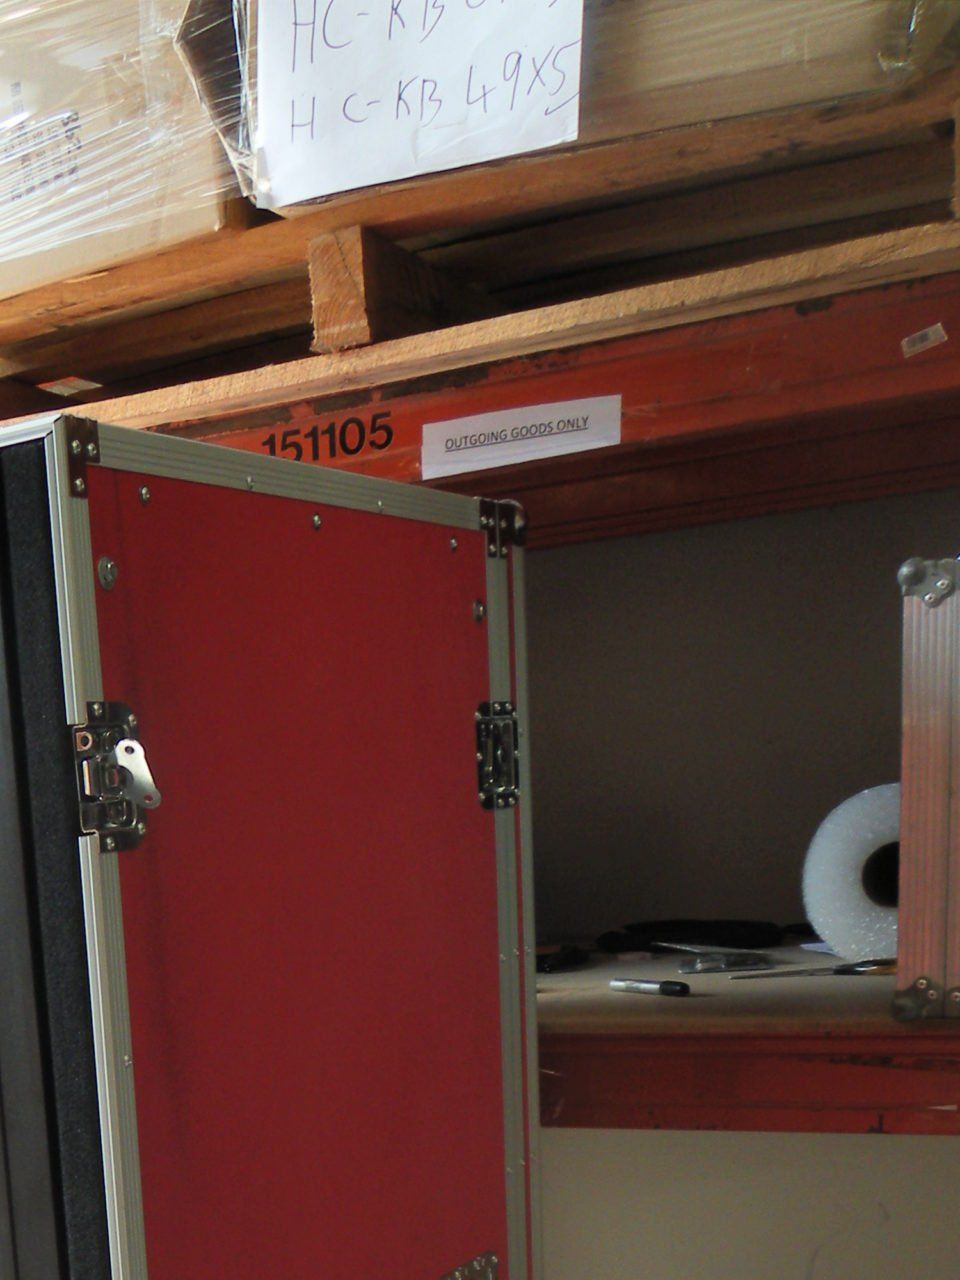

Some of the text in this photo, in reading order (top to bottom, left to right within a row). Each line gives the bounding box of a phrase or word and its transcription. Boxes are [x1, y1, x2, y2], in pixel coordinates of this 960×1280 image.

[262, 411, 394, 463] 151105
[444, 415, 590, 452] OUTGOING GOODS ONLY
